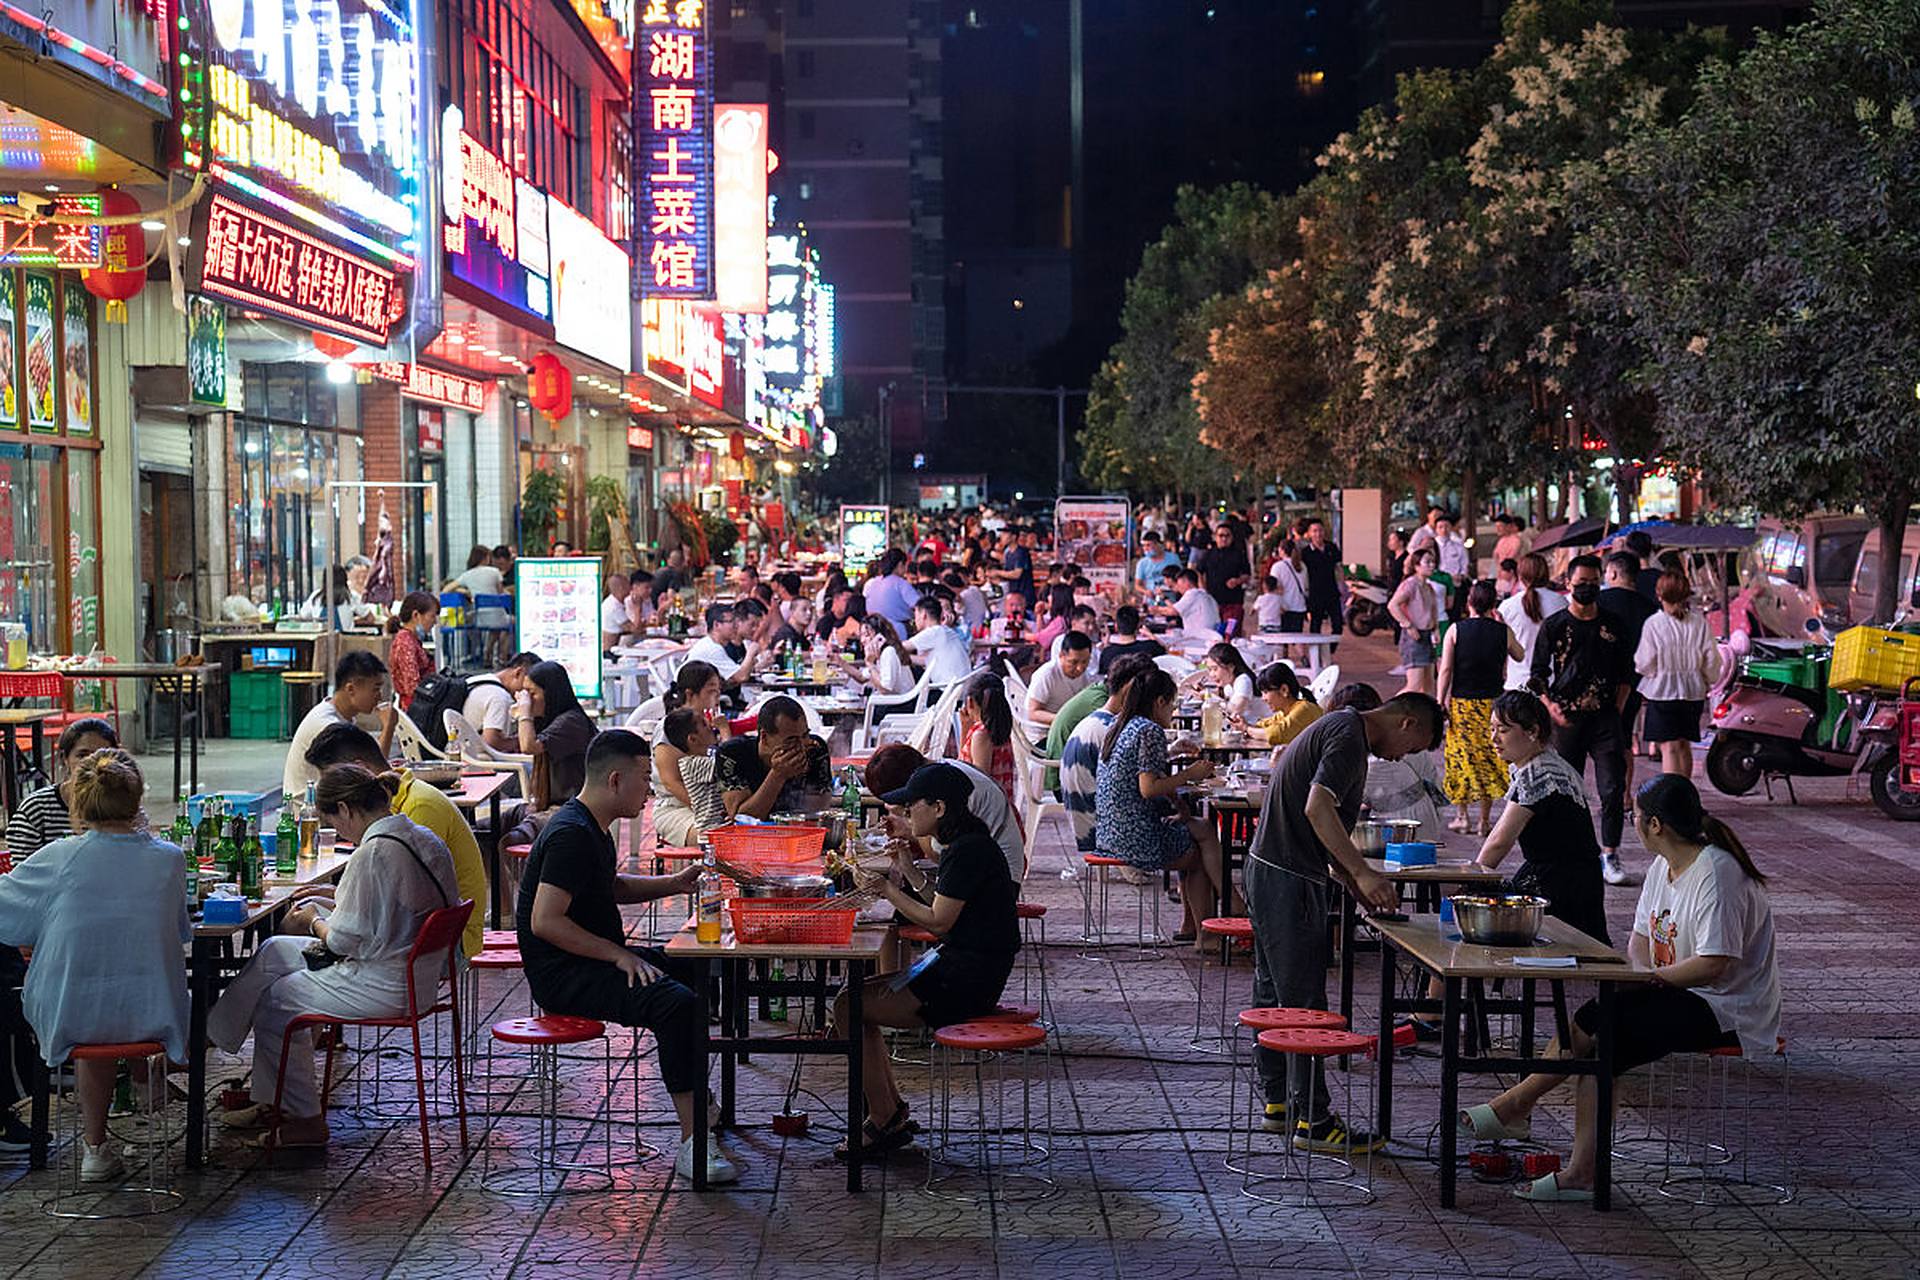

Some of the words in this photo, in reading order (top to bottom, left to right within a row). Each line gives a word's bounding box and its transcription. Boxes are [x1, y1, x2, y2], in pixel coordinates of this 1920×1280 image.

[648, 31, 697, 288] 湖南土菜馆
